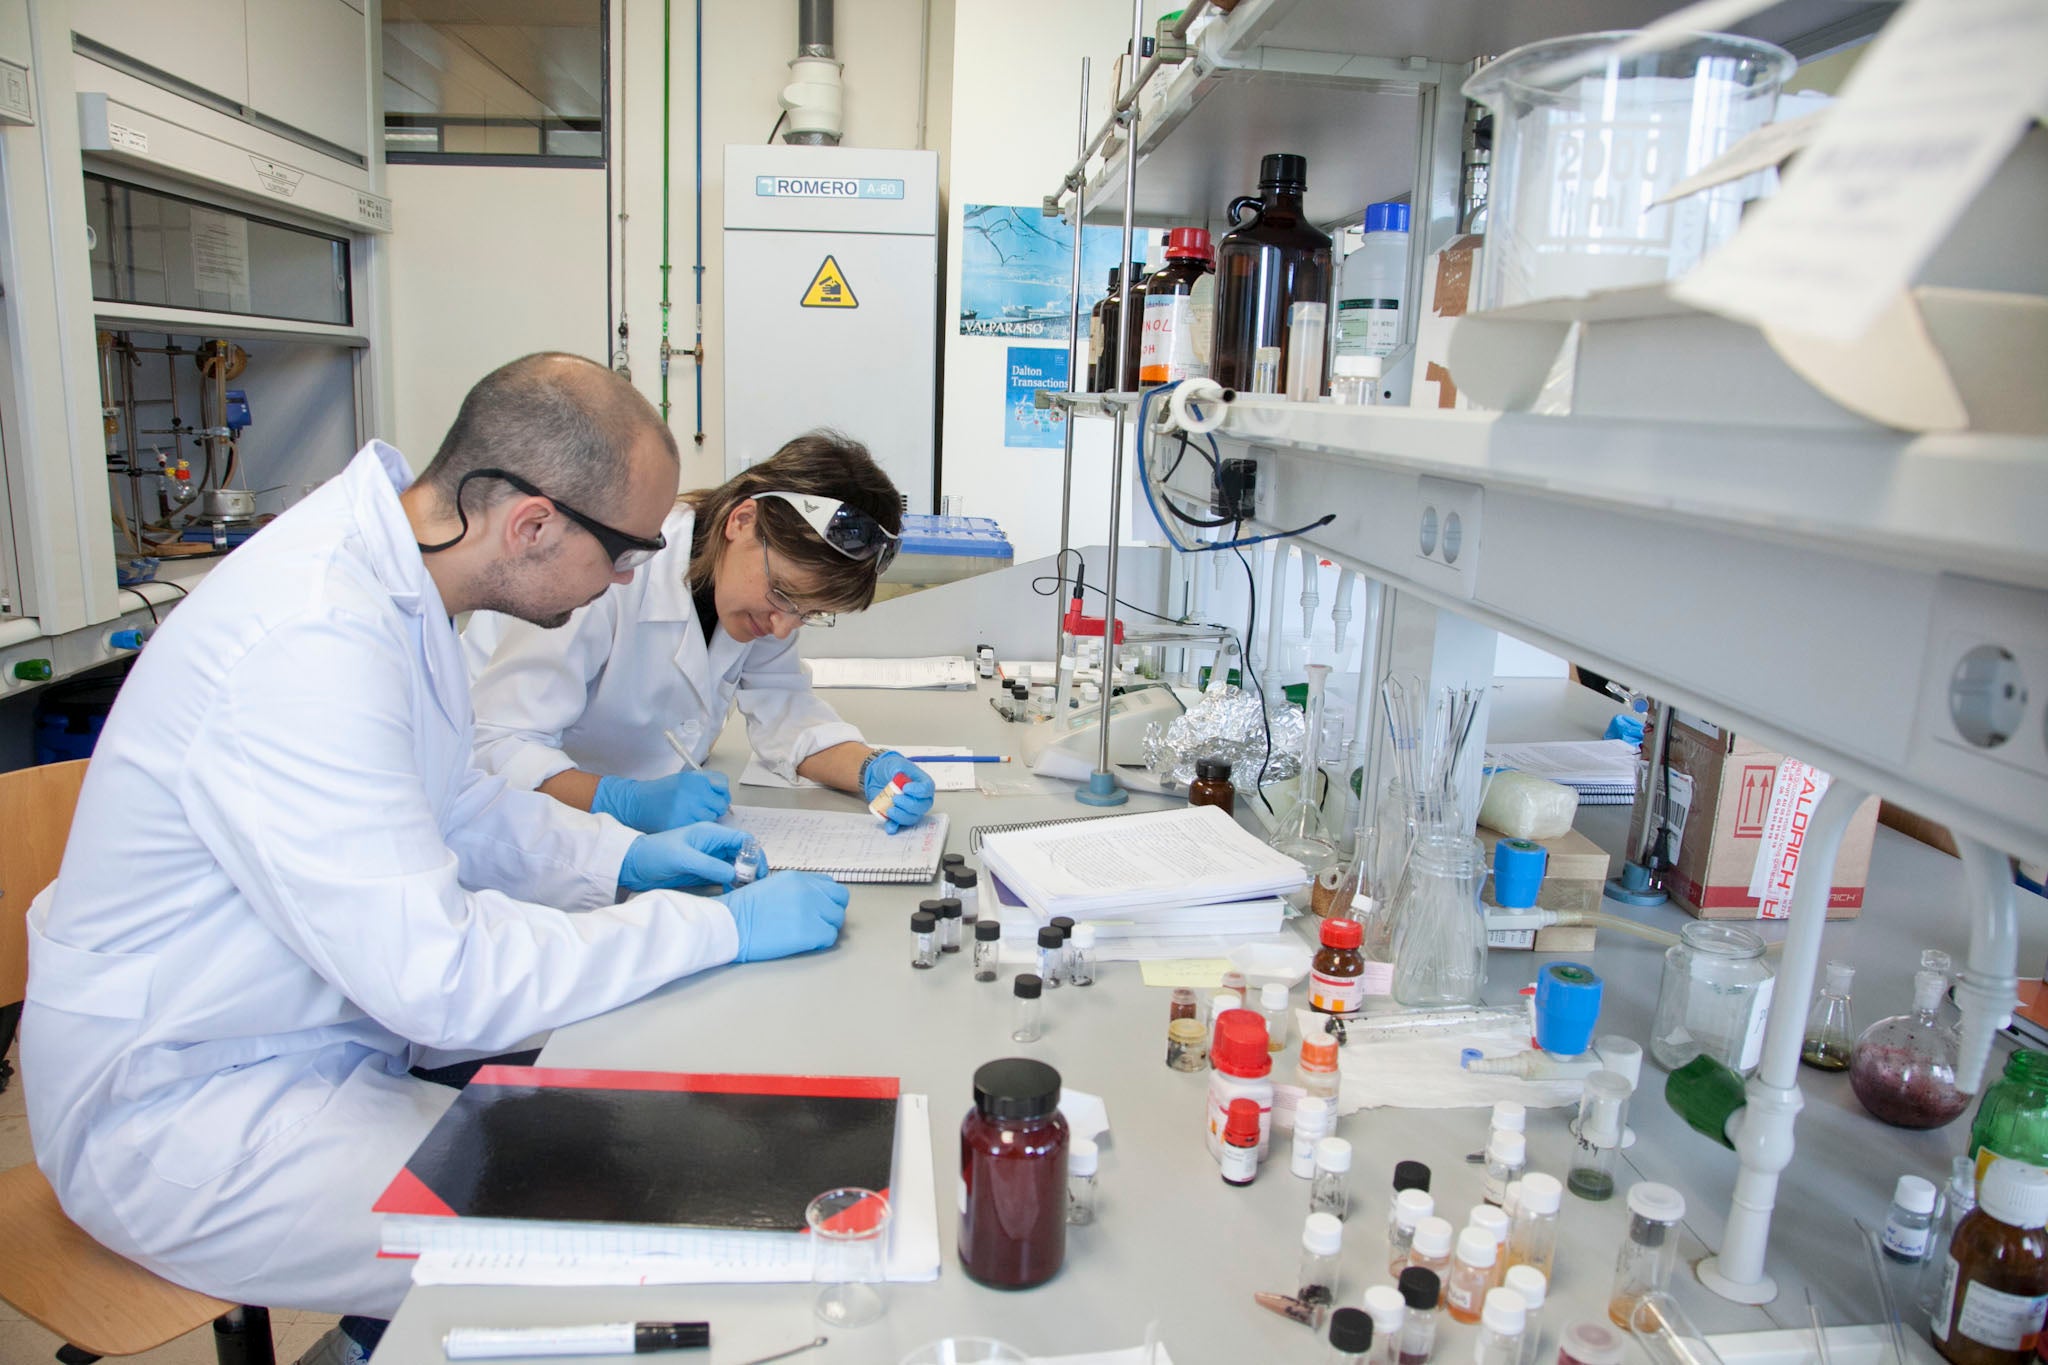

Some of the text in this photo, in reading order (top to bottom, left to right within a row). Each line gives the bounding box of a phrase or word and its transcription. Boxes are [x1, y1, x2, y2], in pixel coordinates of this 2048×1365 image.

[1558, 138, 1662, 182] 2000
[778, 180, 857, 195] ROMERO
[1142, 319, 1172, 332] NOL
[1012, 365, 1042, 376] Dalton
[1011, 376, 1069, 388] Transactions
